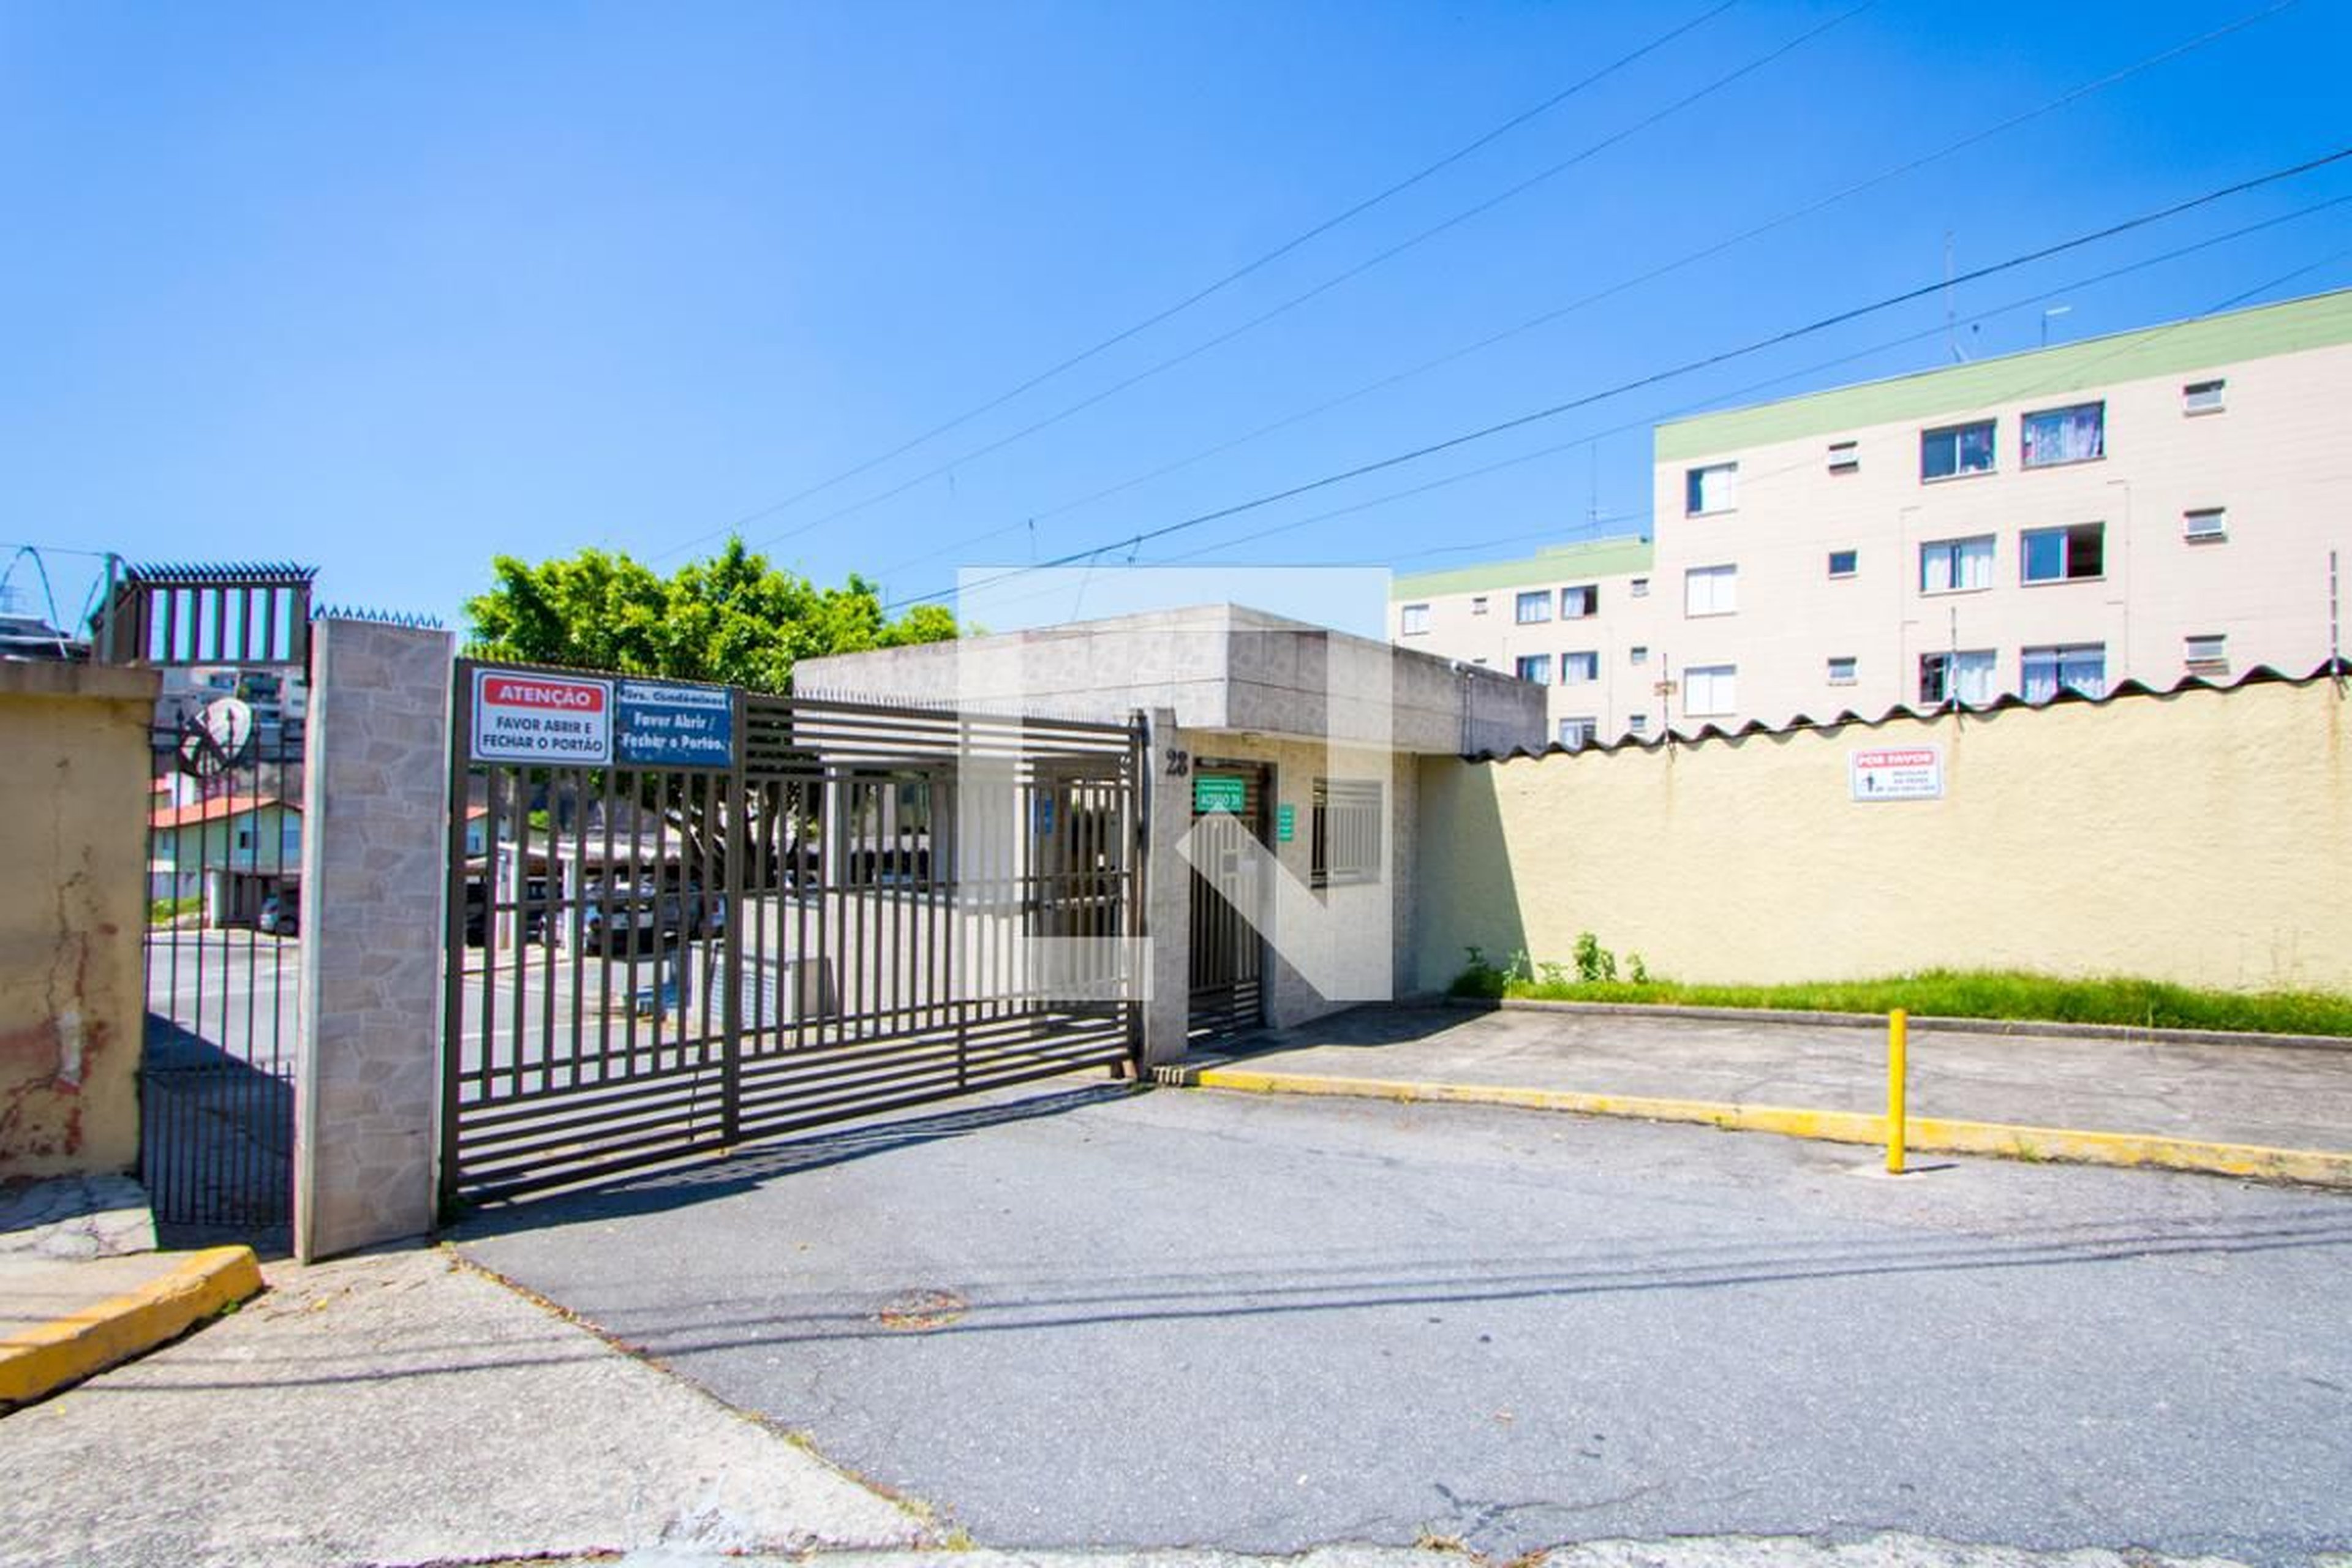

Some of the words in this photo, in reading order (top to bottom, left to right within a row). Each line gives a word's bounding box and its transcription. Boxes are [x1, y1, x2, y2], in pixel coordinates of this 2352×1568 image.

[499, 685, 591, 709] ATENÇÃO
[496, 716, 540, 732] FAVOR
[544, 719, 581, 734] ABRIR
[585, 722, 592, 734] E
[483, 734, 532, 748] FECHAR
[537, 738, 548, 750] O
[552, 737, 603, 752] PORTÃO
[1166, 748, 1188, 777] 28
